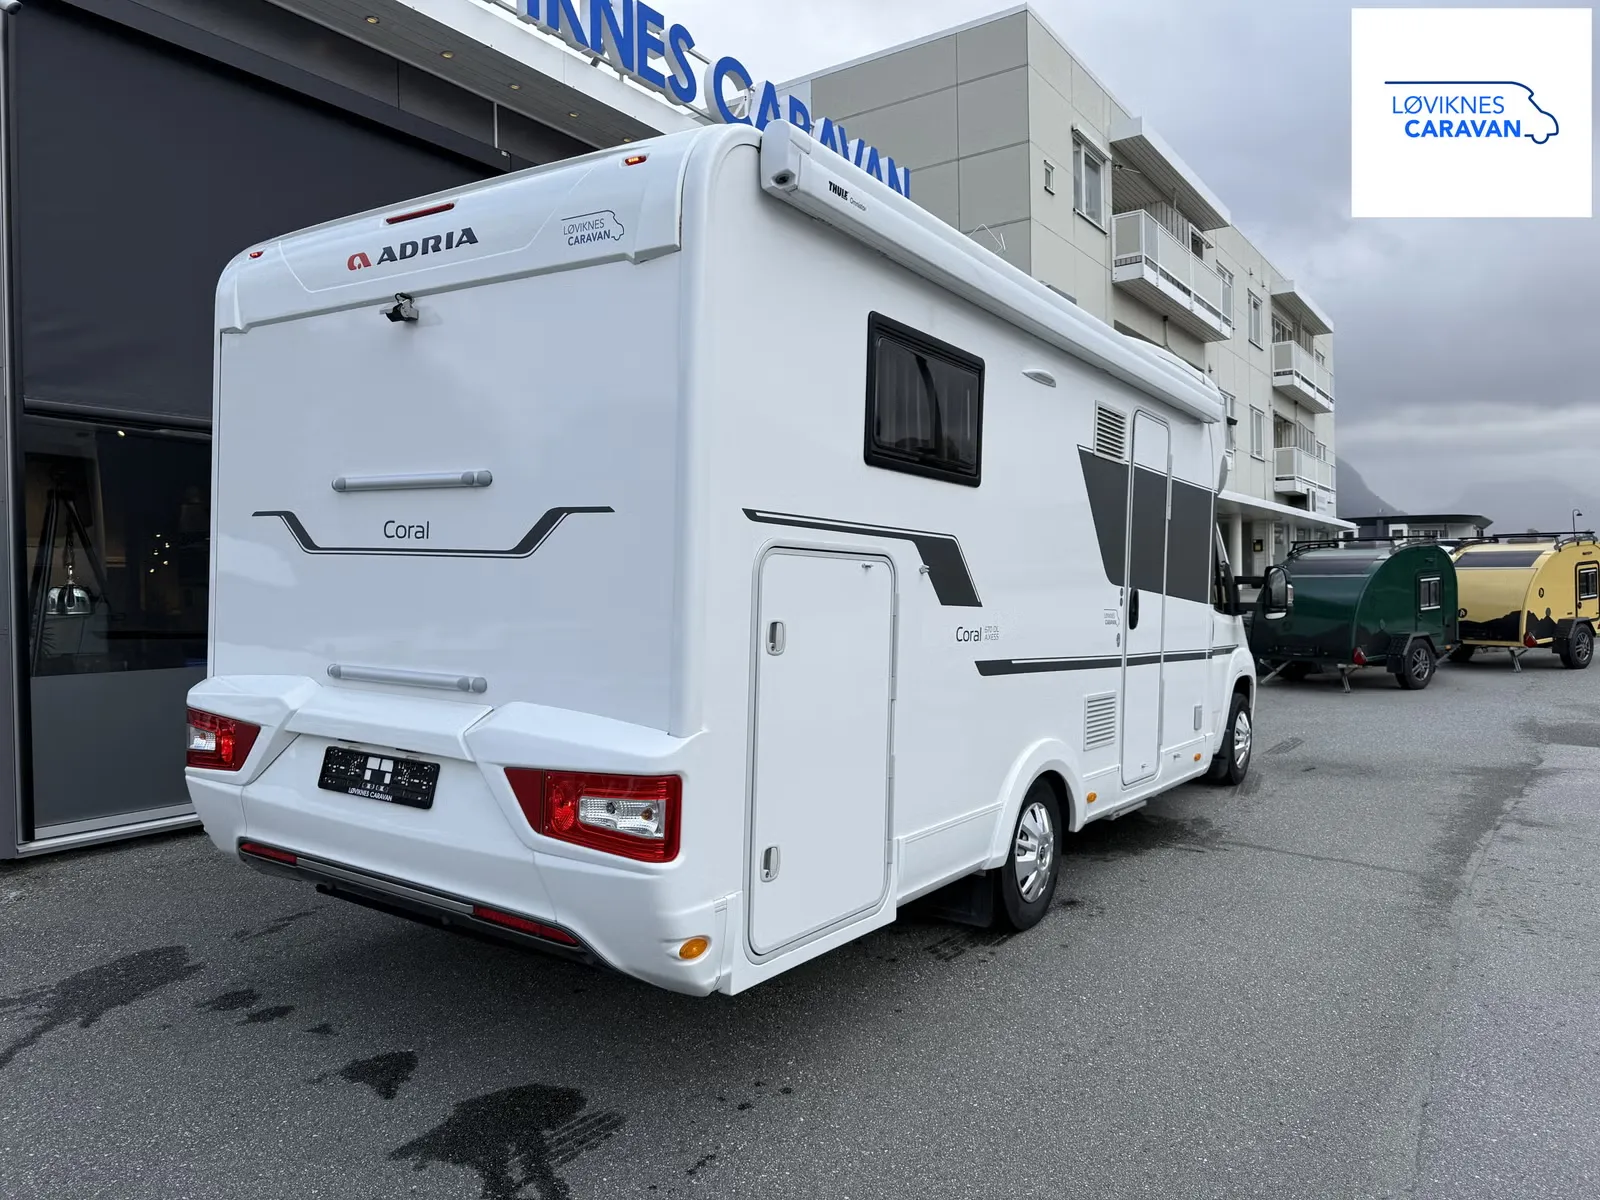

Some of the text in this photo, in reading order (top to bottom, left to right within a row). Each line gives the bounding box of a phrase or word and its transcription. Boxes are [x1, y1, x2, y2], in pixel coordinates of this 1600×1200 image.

[517, 0, 910, 199] NES CARAVAN
[828, 181, 849, 201] THULE
[563, 218, 605, 235] LØVIKNES
[377, 227, 479, 266] ADRIA
[567, 229, 611, 246] CARAVAN
[383, 520, 430, 539] Coral
[956, 626, 982, 643] Coral
[370, 791, 392, 801] CARAVAN
